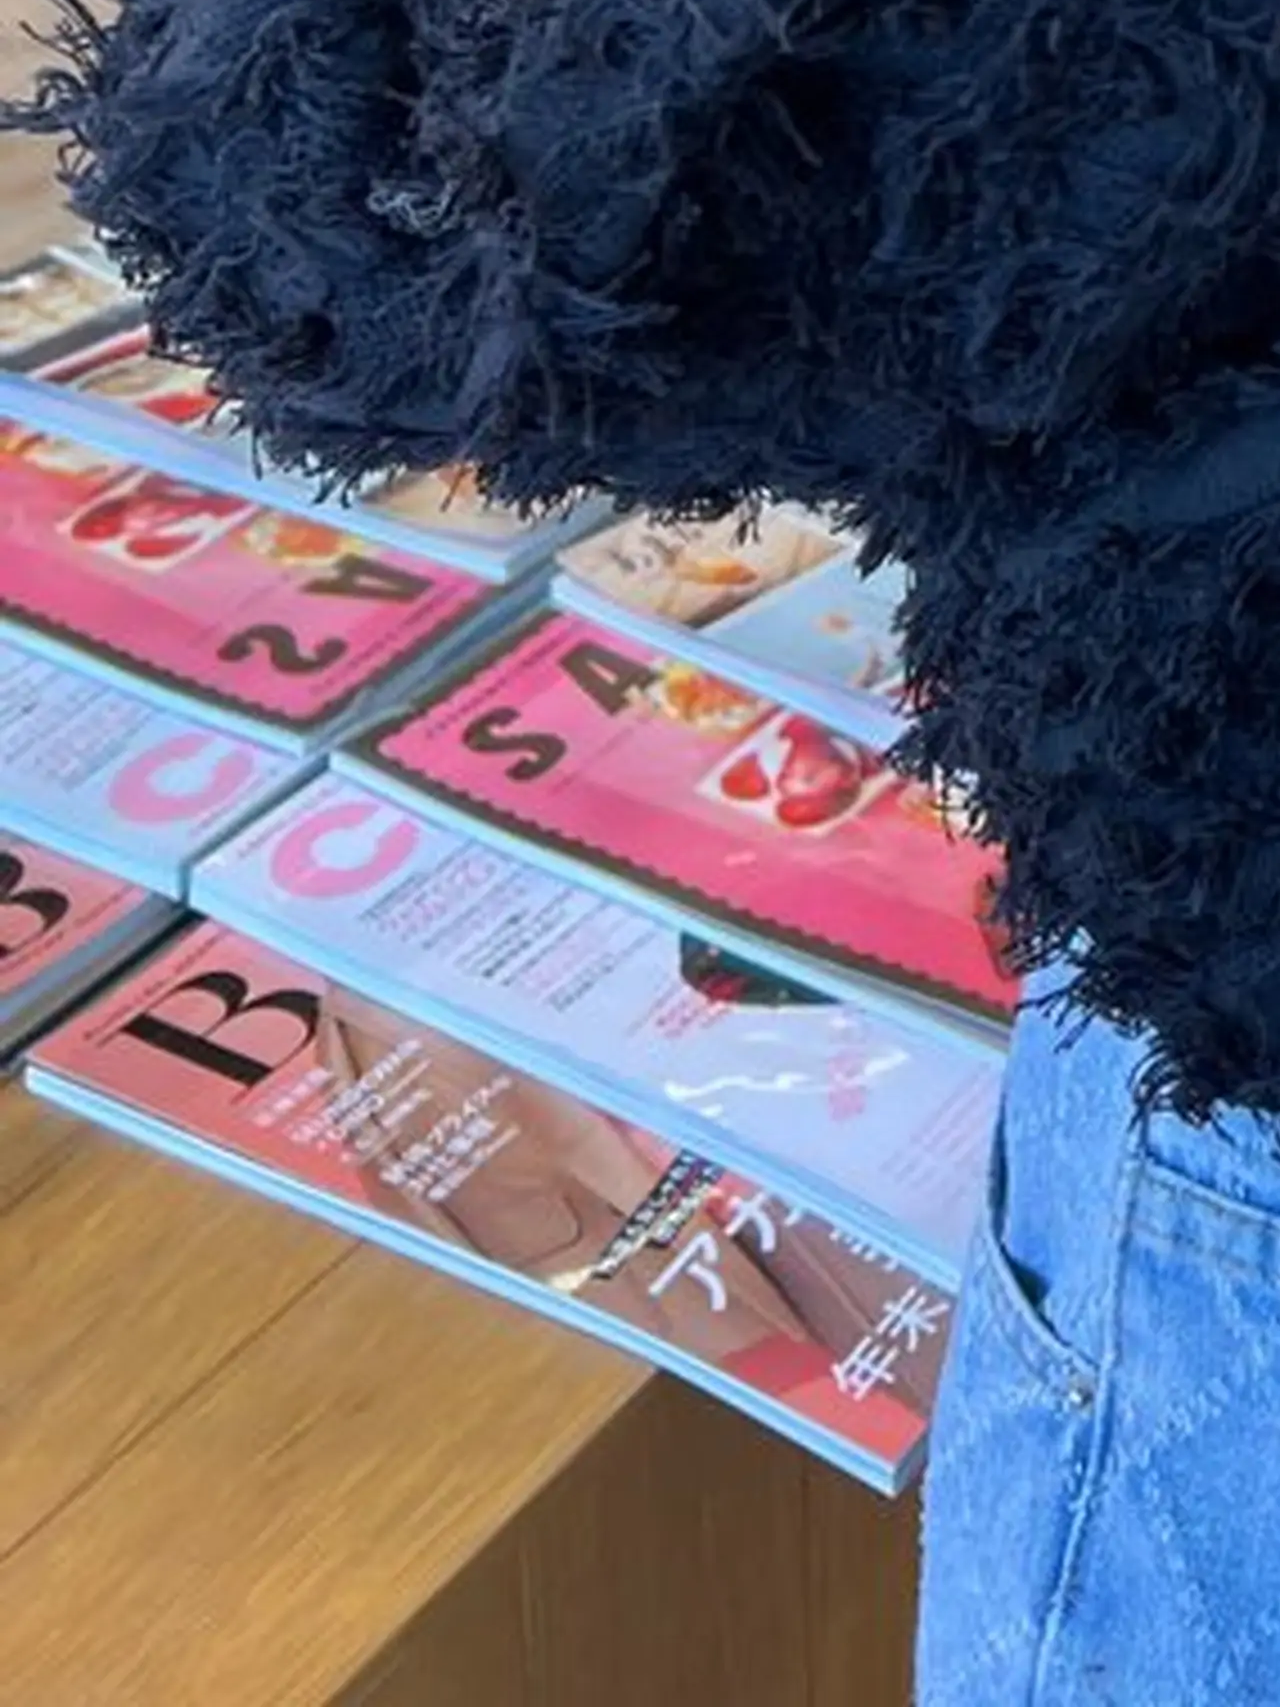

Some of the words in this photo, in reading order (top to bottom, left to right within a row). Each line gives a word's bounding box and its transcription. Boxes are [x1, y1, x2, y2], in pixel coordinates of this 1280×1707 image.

[269, 801, 420, 899] C
[96, 971, 320, 1105] B
[648, 1190, 801, 1311] アナ
[830, 1285, 949, 1400] 年末
